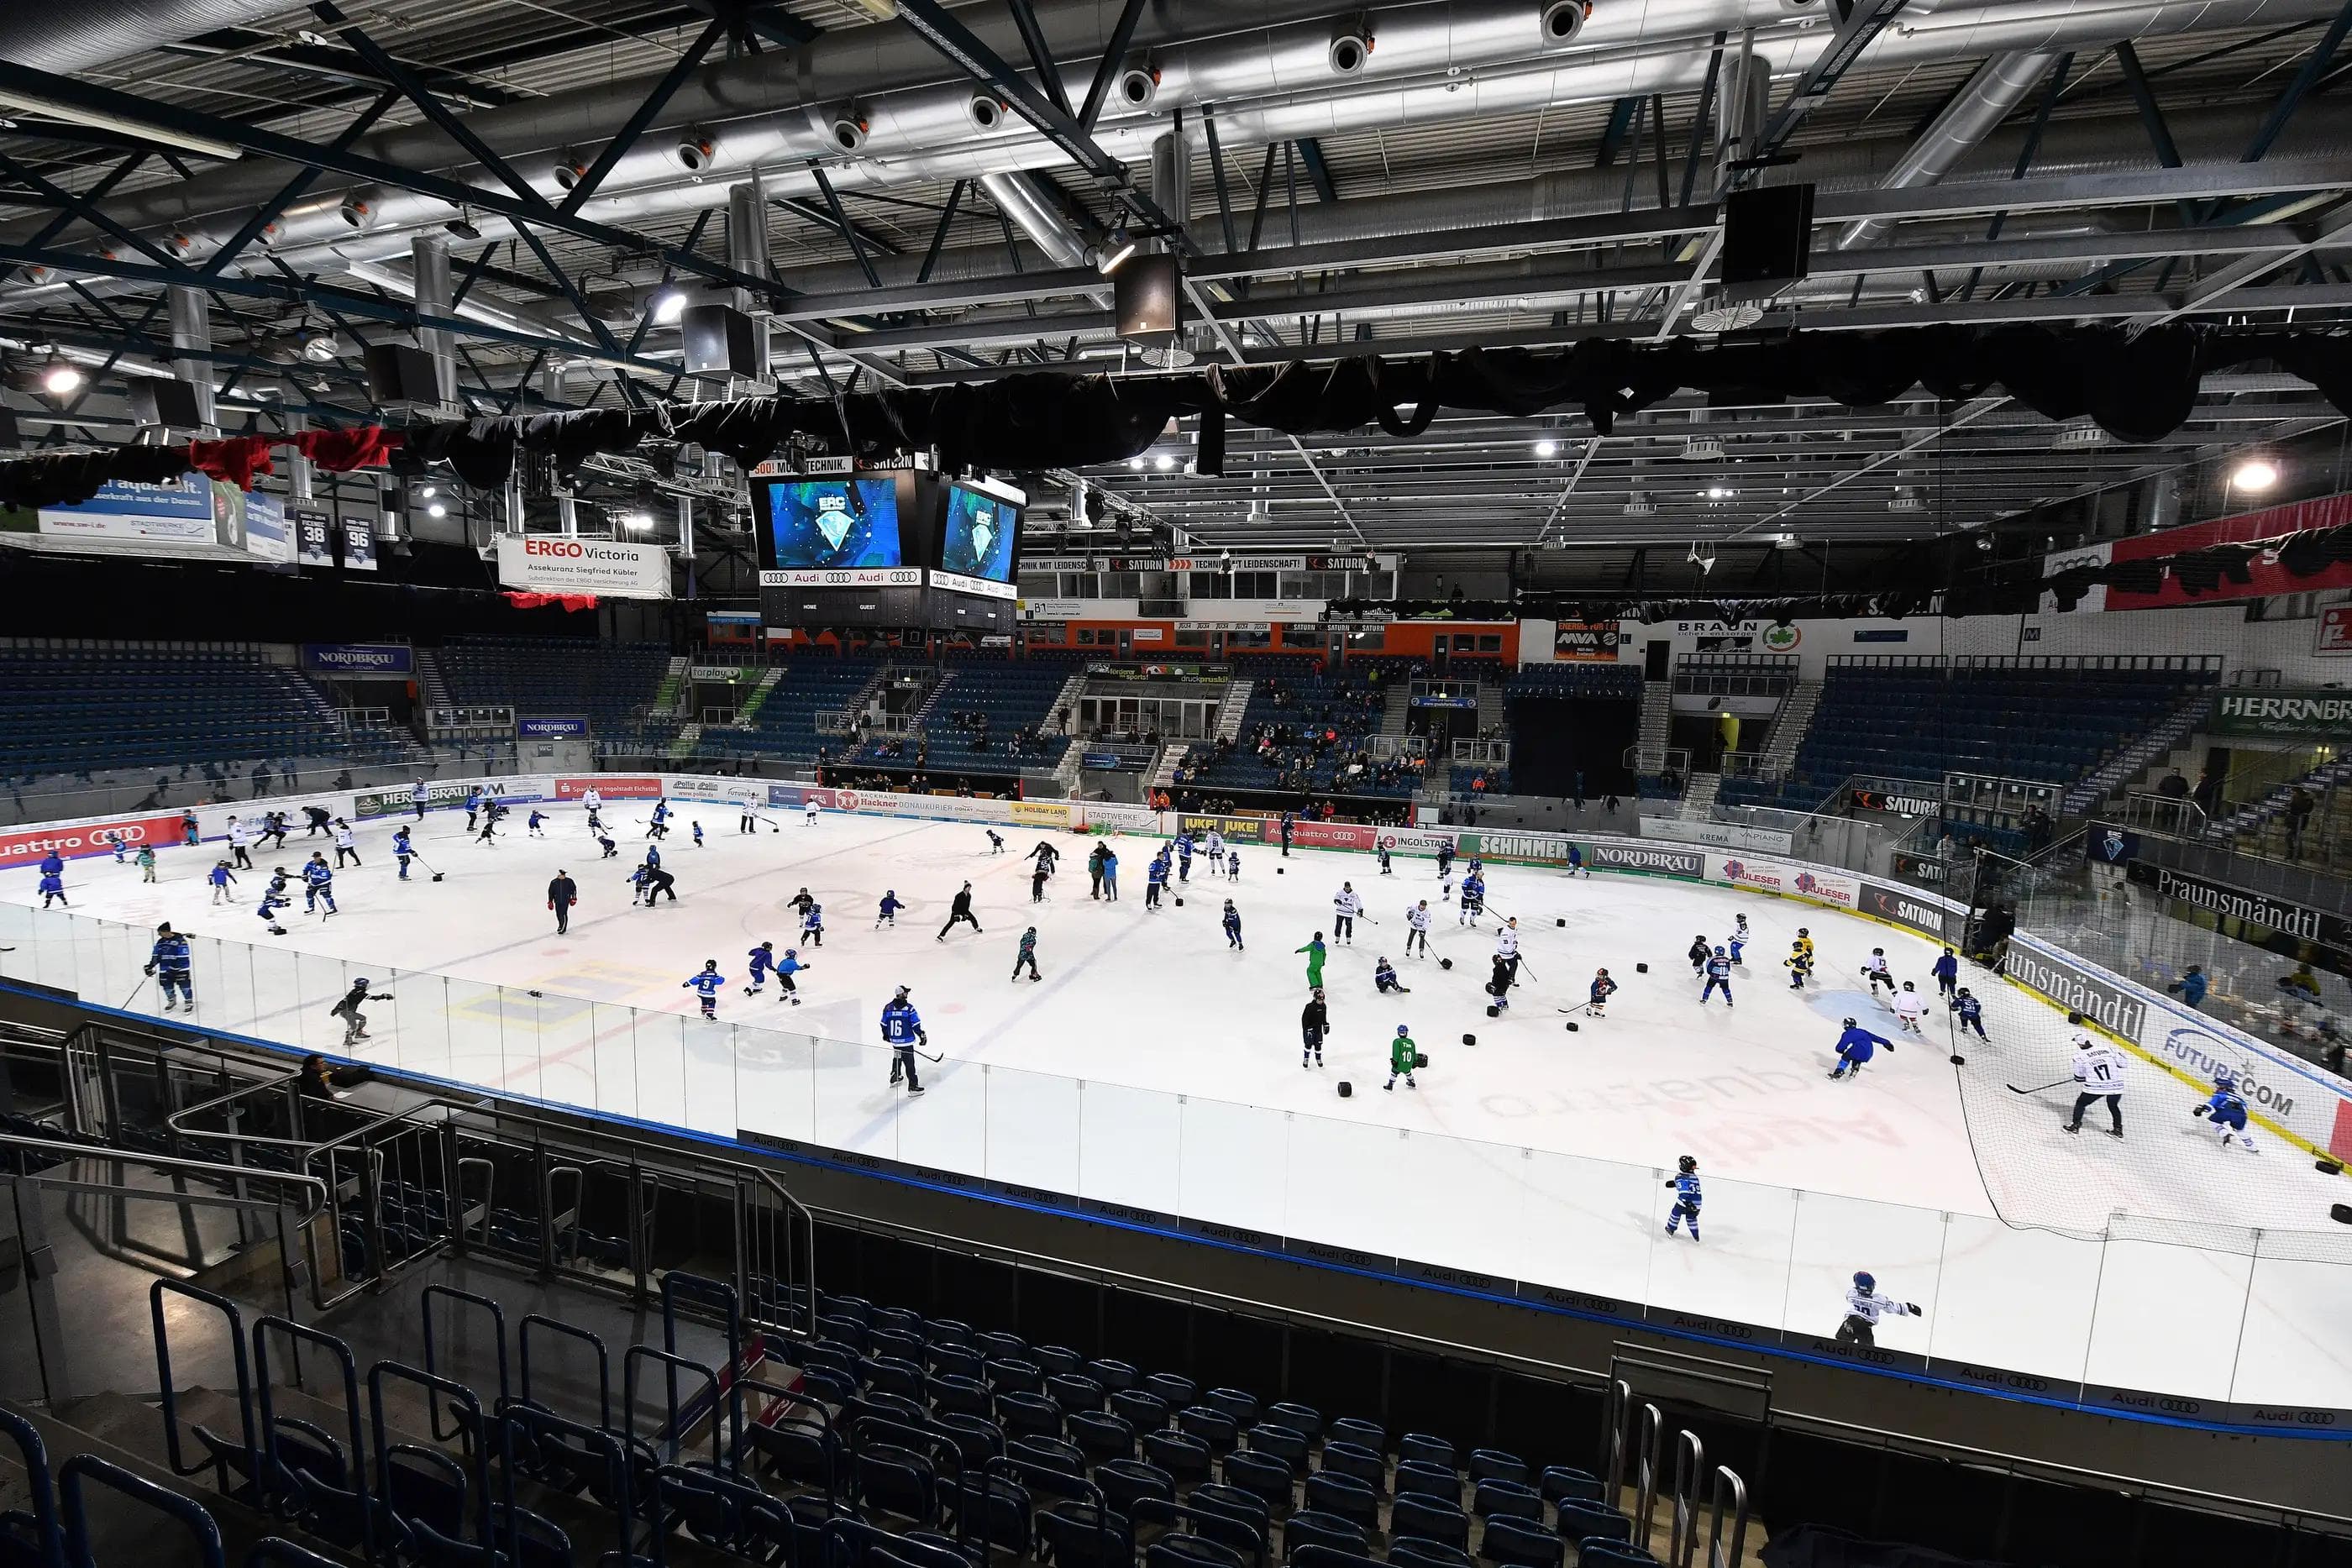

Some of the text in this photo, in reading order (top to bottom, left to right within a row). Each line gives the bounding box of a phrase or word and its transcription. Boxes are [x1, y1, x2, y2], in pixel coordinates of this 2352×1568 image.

[806, 459, 846, 472] TECHNIK.
[819, 497, 845, 506] ERC
[304, 527, 325, 543] 38
[349, 531, 369, 548] 96
[525, 540, 638, 562] ERGO Victoria
[1039, 560, 1051, 569] MIT
[1129, 560, 1163, 570] SATURN
[1244, 559, 1300, 569] LEIDENSCHAFT!
[1327, 558, 1365, 569] SATURN
[528, 564, 638, 577] Assekuranz Siegfried Kübler
[794, 572, 884, 582] Audi Audi
[1678, 622, 1757, 631] BRAUN
[1557, 632, 1599, 644] MVA
[2025, 631, 2039, 640] M
[318, 652, 394, 664] NORDBRÄU
[527, 722, 578, 732] NORDBRÄU
[860, 798, 898, 808] Hackner
[899, 801, 953, 811] DONAUKURIER
[1885, 795, 1941, 816] SATURN
[1024, 806, 1048, 815] HOLIDAY
[1088, 811, 1137, 821] STADTWERKE
[1184, 818, 1259, 834] JUKE! JUKE!
[1294, 830, 1329, 839] quattro
[1700, 832, 1729, 843] KREMA
[1479, 836, 1567, 858] SCHIMMER
[1596, 848, 1698, 872] NORDBRÄU
[2157, 869, 2321, 941] Praunsmändtl
[1898, 900, 1942, 931] SATURN
[702, 979, 711, 989] 9
[890, 1020, 902, 1036] 16
[1402, 1051, 1412, 1062] 10
[2093, 1063, 2111, 1081] 17
[753, 1135, 775, 1147] Audi
[832, 1151, 855, 1163] Audi
[916, 1168, 941, 1182] Audi
[1005, 1186, 1032, 1198] Audi
[1100, 1204, 1128, 1218] Audi
[1200, 1224, 1230, 1239] Audi
[1307, 1245, 1340, 1259] Audi
[1422, 1266, 1457, 1282] Audi
[1544, 1290, 1580, 1307] Audi
[1673, 1315, 1713, 1332] Audi
[1813, 1341, 1852, 1358] Audi
[1960, 1366, 2003, 1385] Audi
[2111, 1392, 2155, 1408] Audi
[2255, 1408, 2293, 1422] Audi
